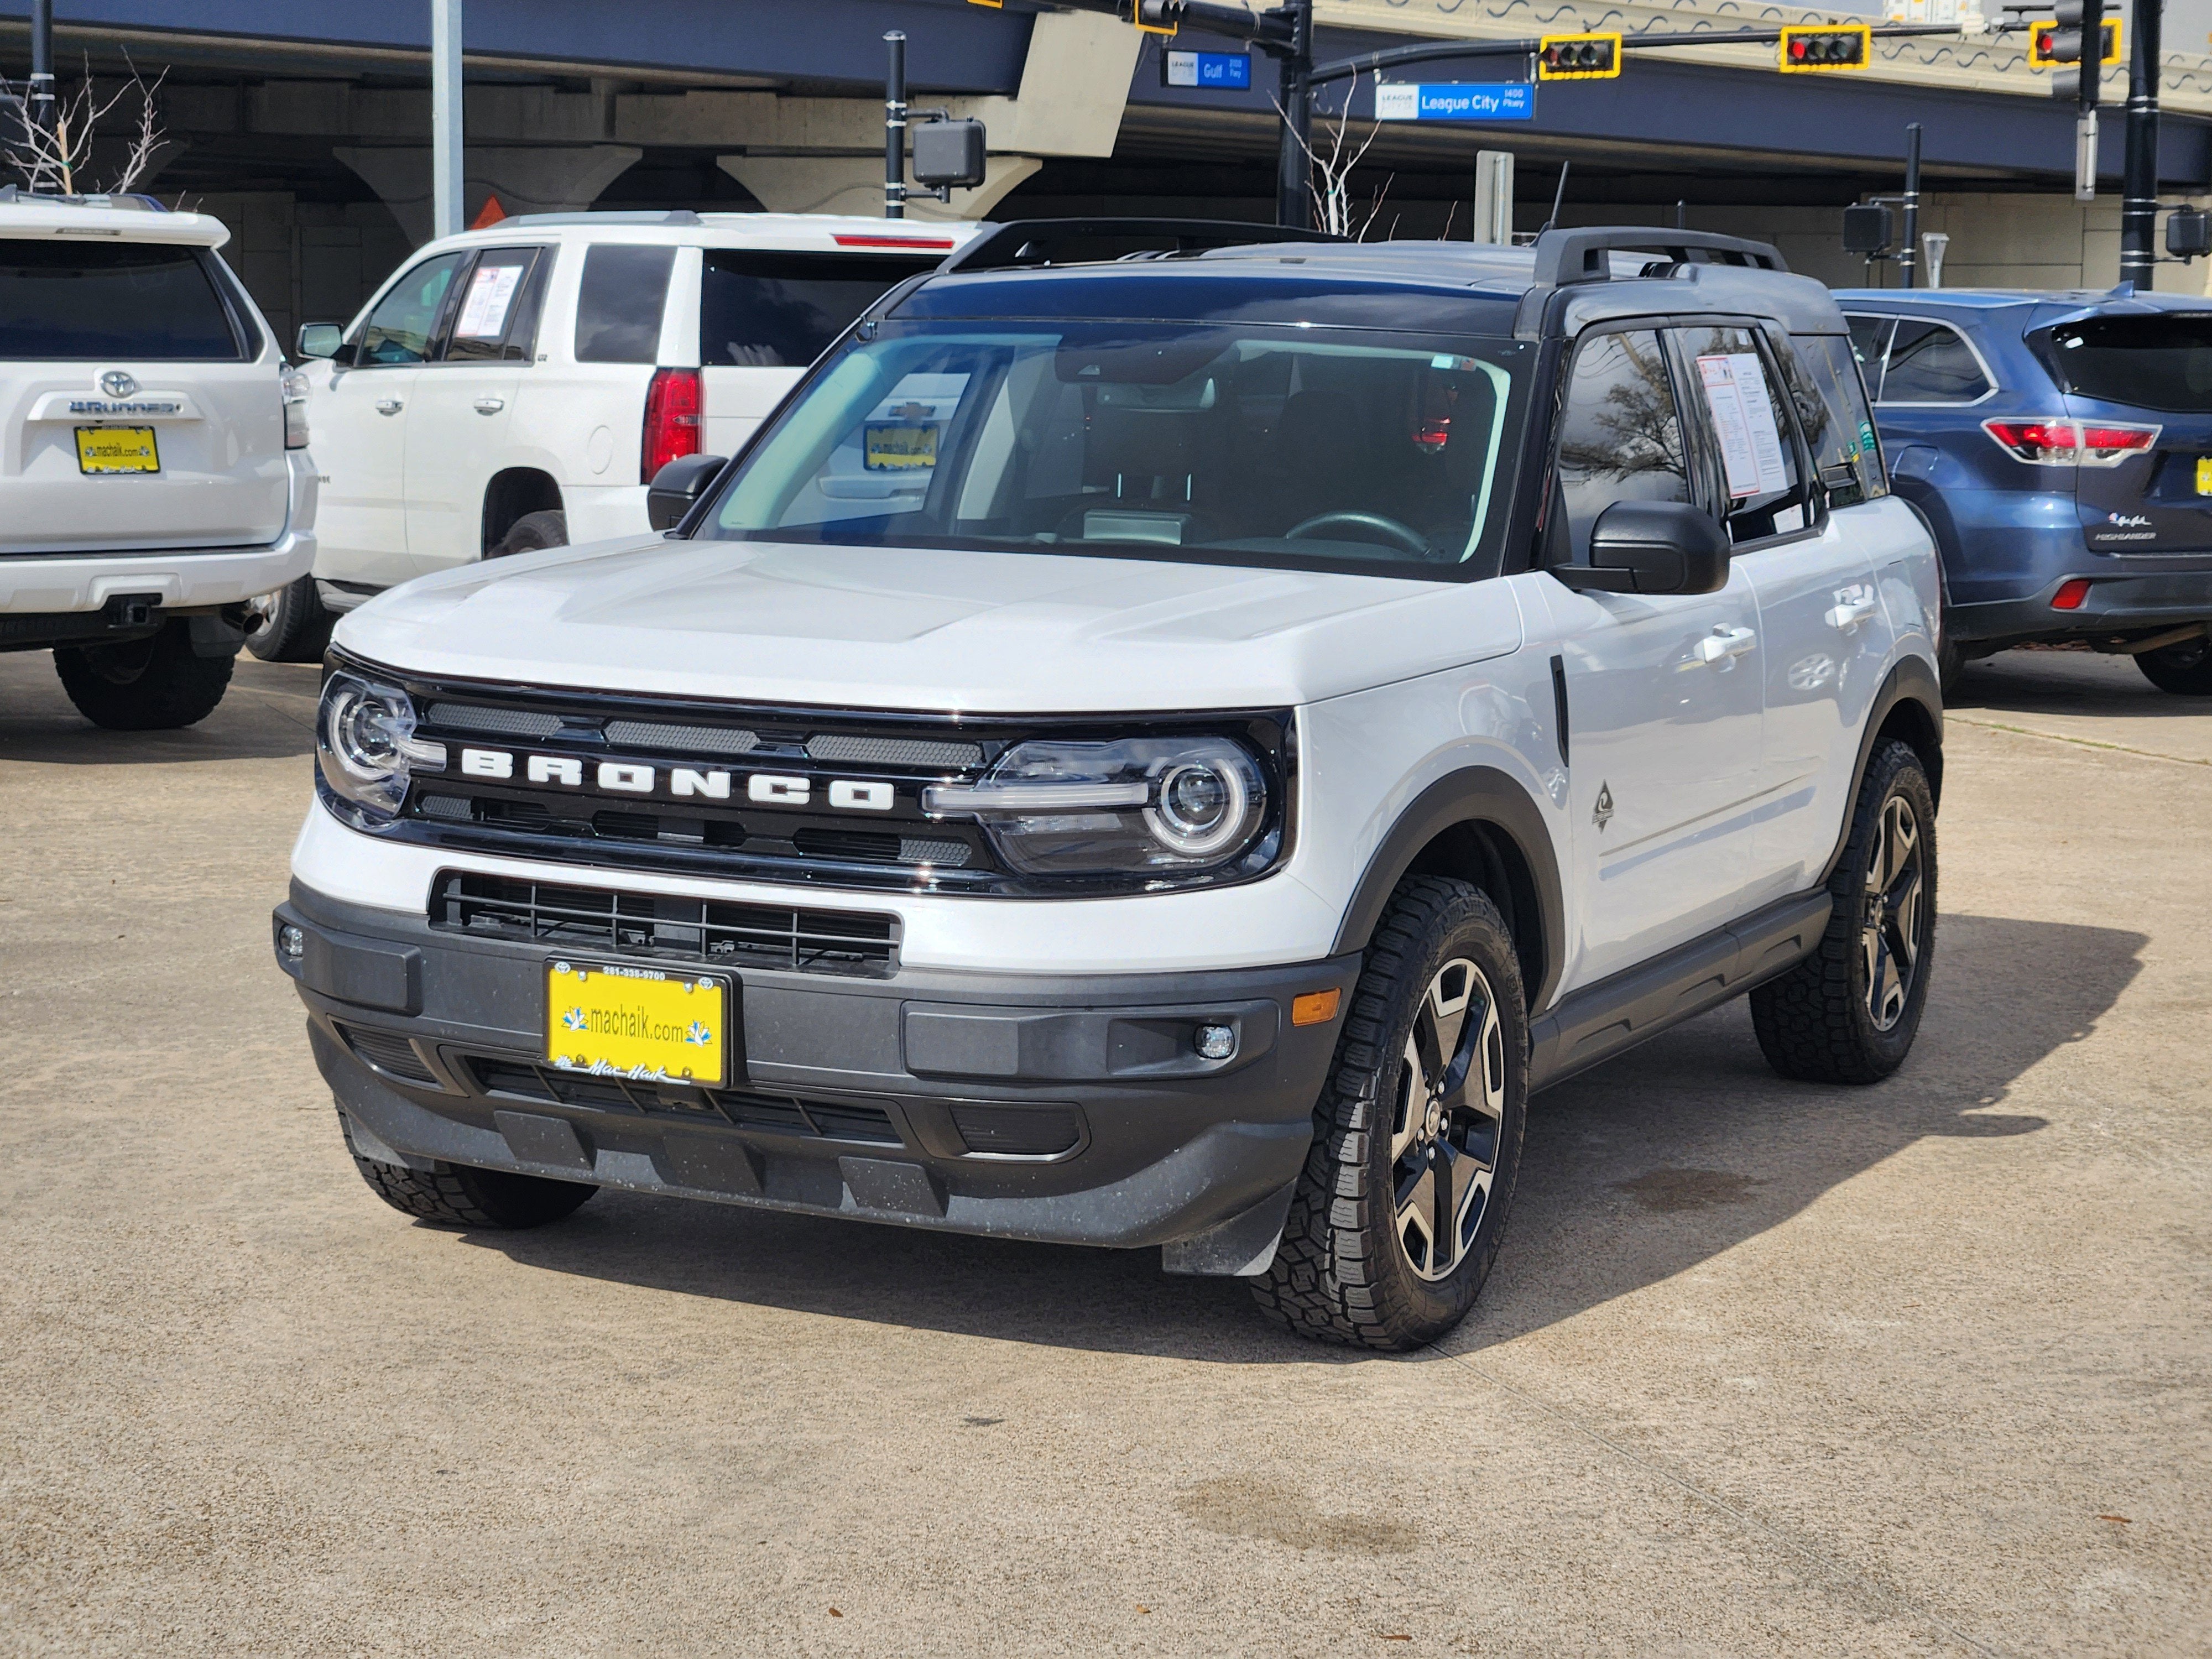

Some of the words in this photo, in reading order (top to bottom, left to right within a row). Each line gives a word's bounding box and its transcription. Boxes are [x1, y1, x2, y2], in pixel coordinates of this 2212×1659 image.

[1203, 63, 1223, 79] Gulf
[1421, 95, 1470, 114] League
[1472, 95, 1500, 113] City
[2095, 533, 2157, 541] HIGHLANDER
[461, 748, 895, 811] BRONCO
[602, 966, 666, 981] 281-338-9700
[591, 1003, 684, 1043] machaik.com
[588, 1057, 627, 1077] Mac
[627, 1062, 666, 1081] Haik
